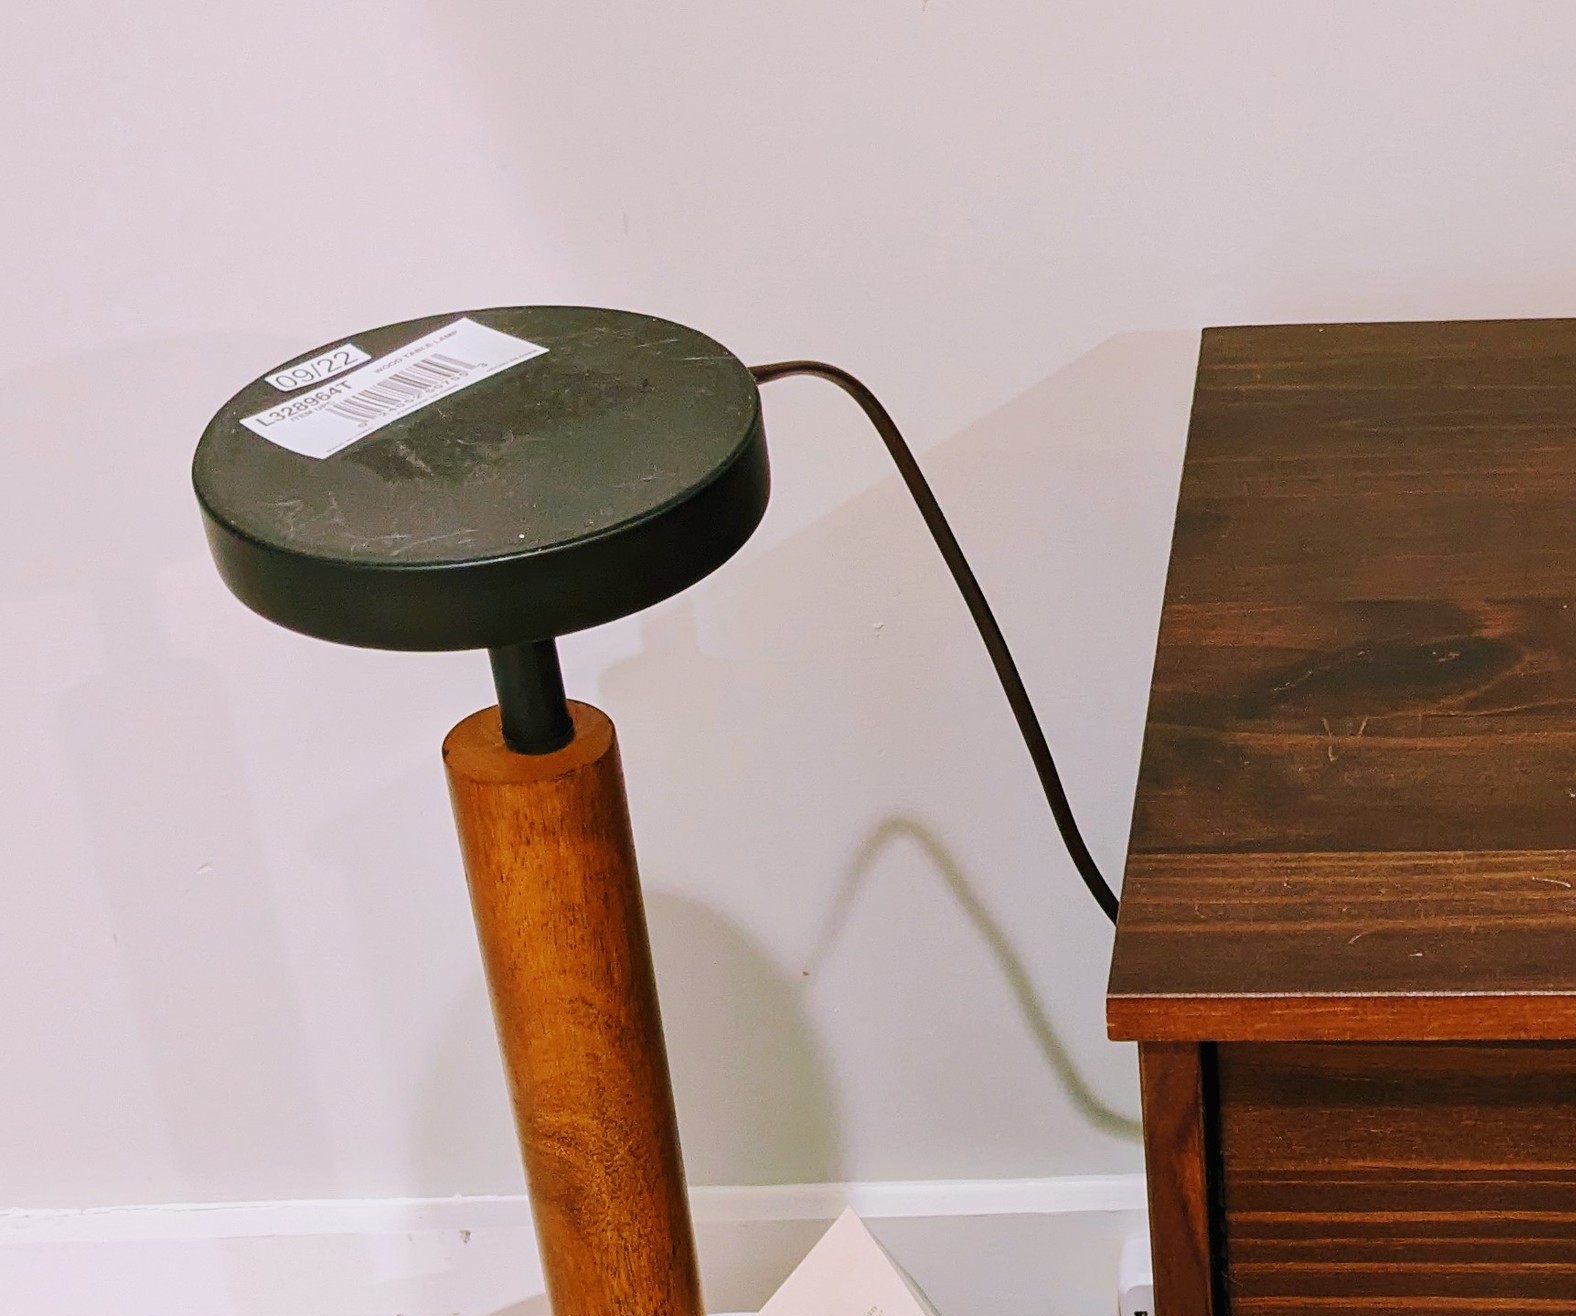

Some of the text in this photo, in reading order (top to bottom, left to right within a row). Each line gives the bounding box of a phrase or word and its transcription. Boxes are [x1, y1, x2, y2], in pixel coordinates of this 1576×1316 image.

[275, 351, 358, 388] 09/22
[374, 357, 403, 374] WOOD
[404, 342, 432, 358] TABLE
[256, 380, 353, 427] L328964T
